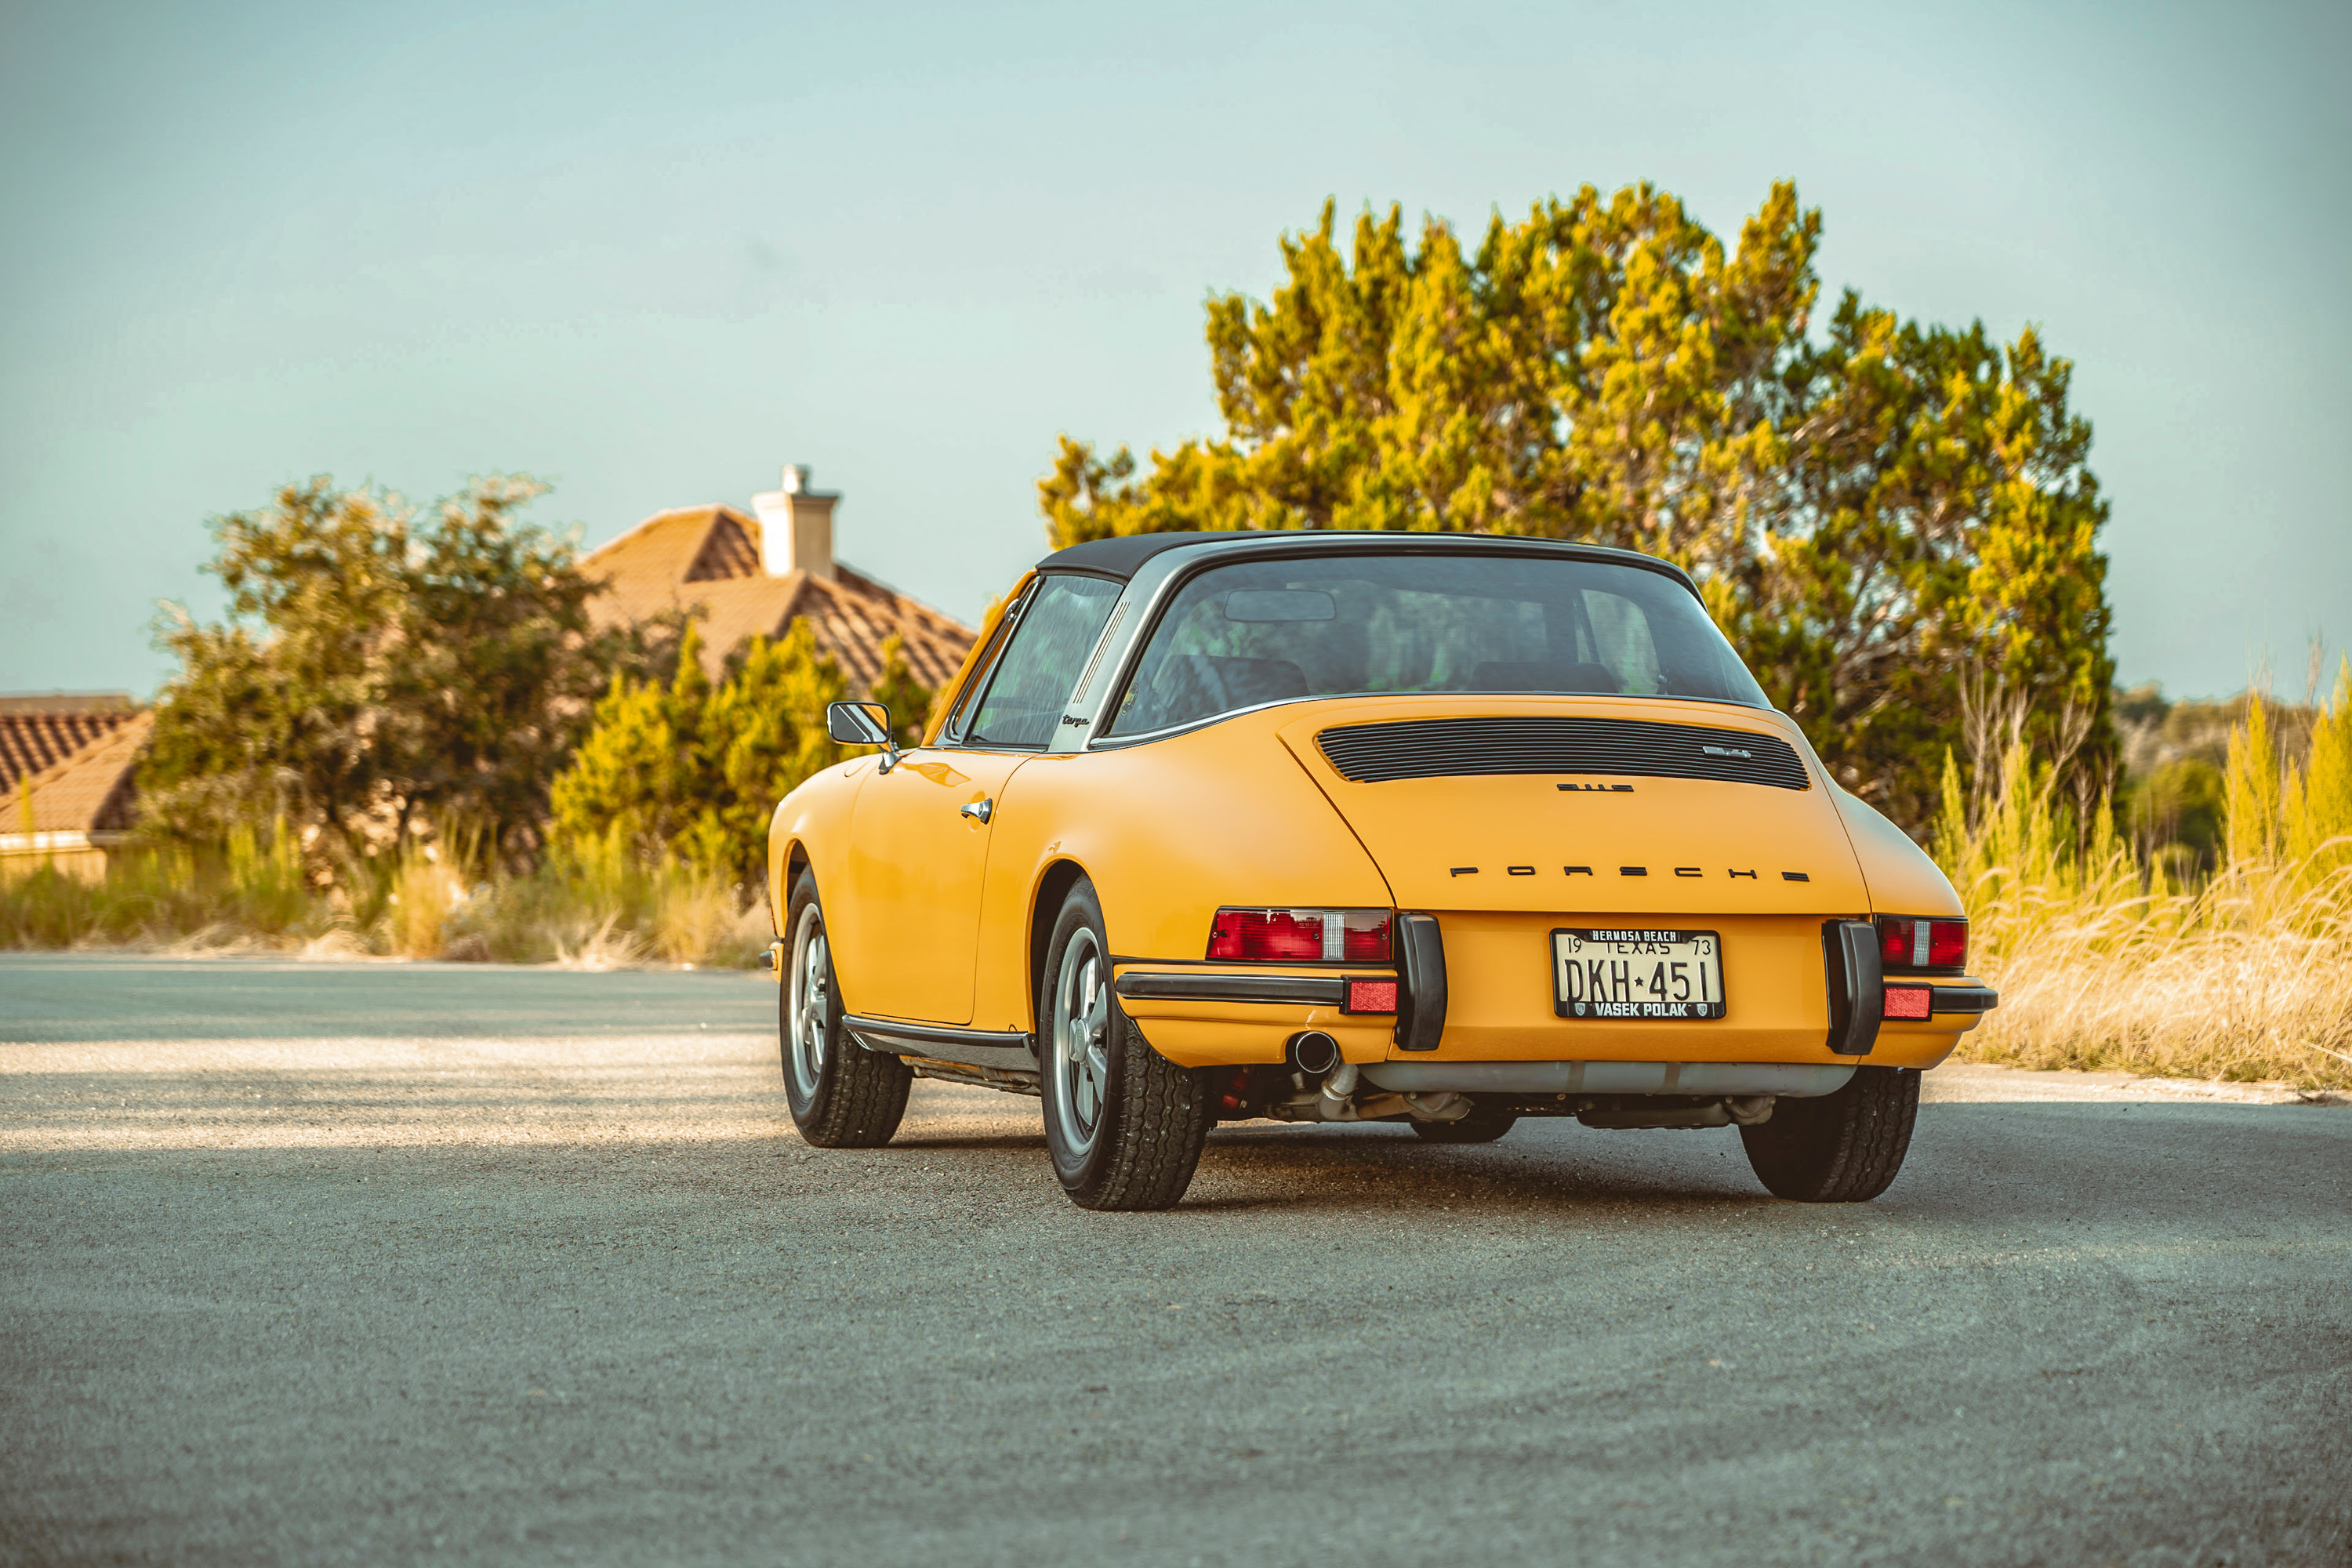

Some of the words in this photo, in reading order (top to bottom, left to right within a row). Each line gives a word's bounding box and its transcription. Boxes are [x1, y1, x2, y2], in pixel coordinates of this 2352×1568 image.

[1450, 866, 1809, 882] PORSCHE
[1592, 930, 1641, 942] HERMOSA
[1644, 931, 1676, 942] BEACH
[1568, 937, 1582, 953] 19
[1607, 942, 1670, 955] TEXAS
[1691, 939, 1711, 955] 73
[1565, 959, 1630, 1002] DKH
[1649, 961, 1708, 1001] 451
[1595, 1003, 1640, 1017] VASEK
[1643, 1003, 1688, 1017] POLAK
